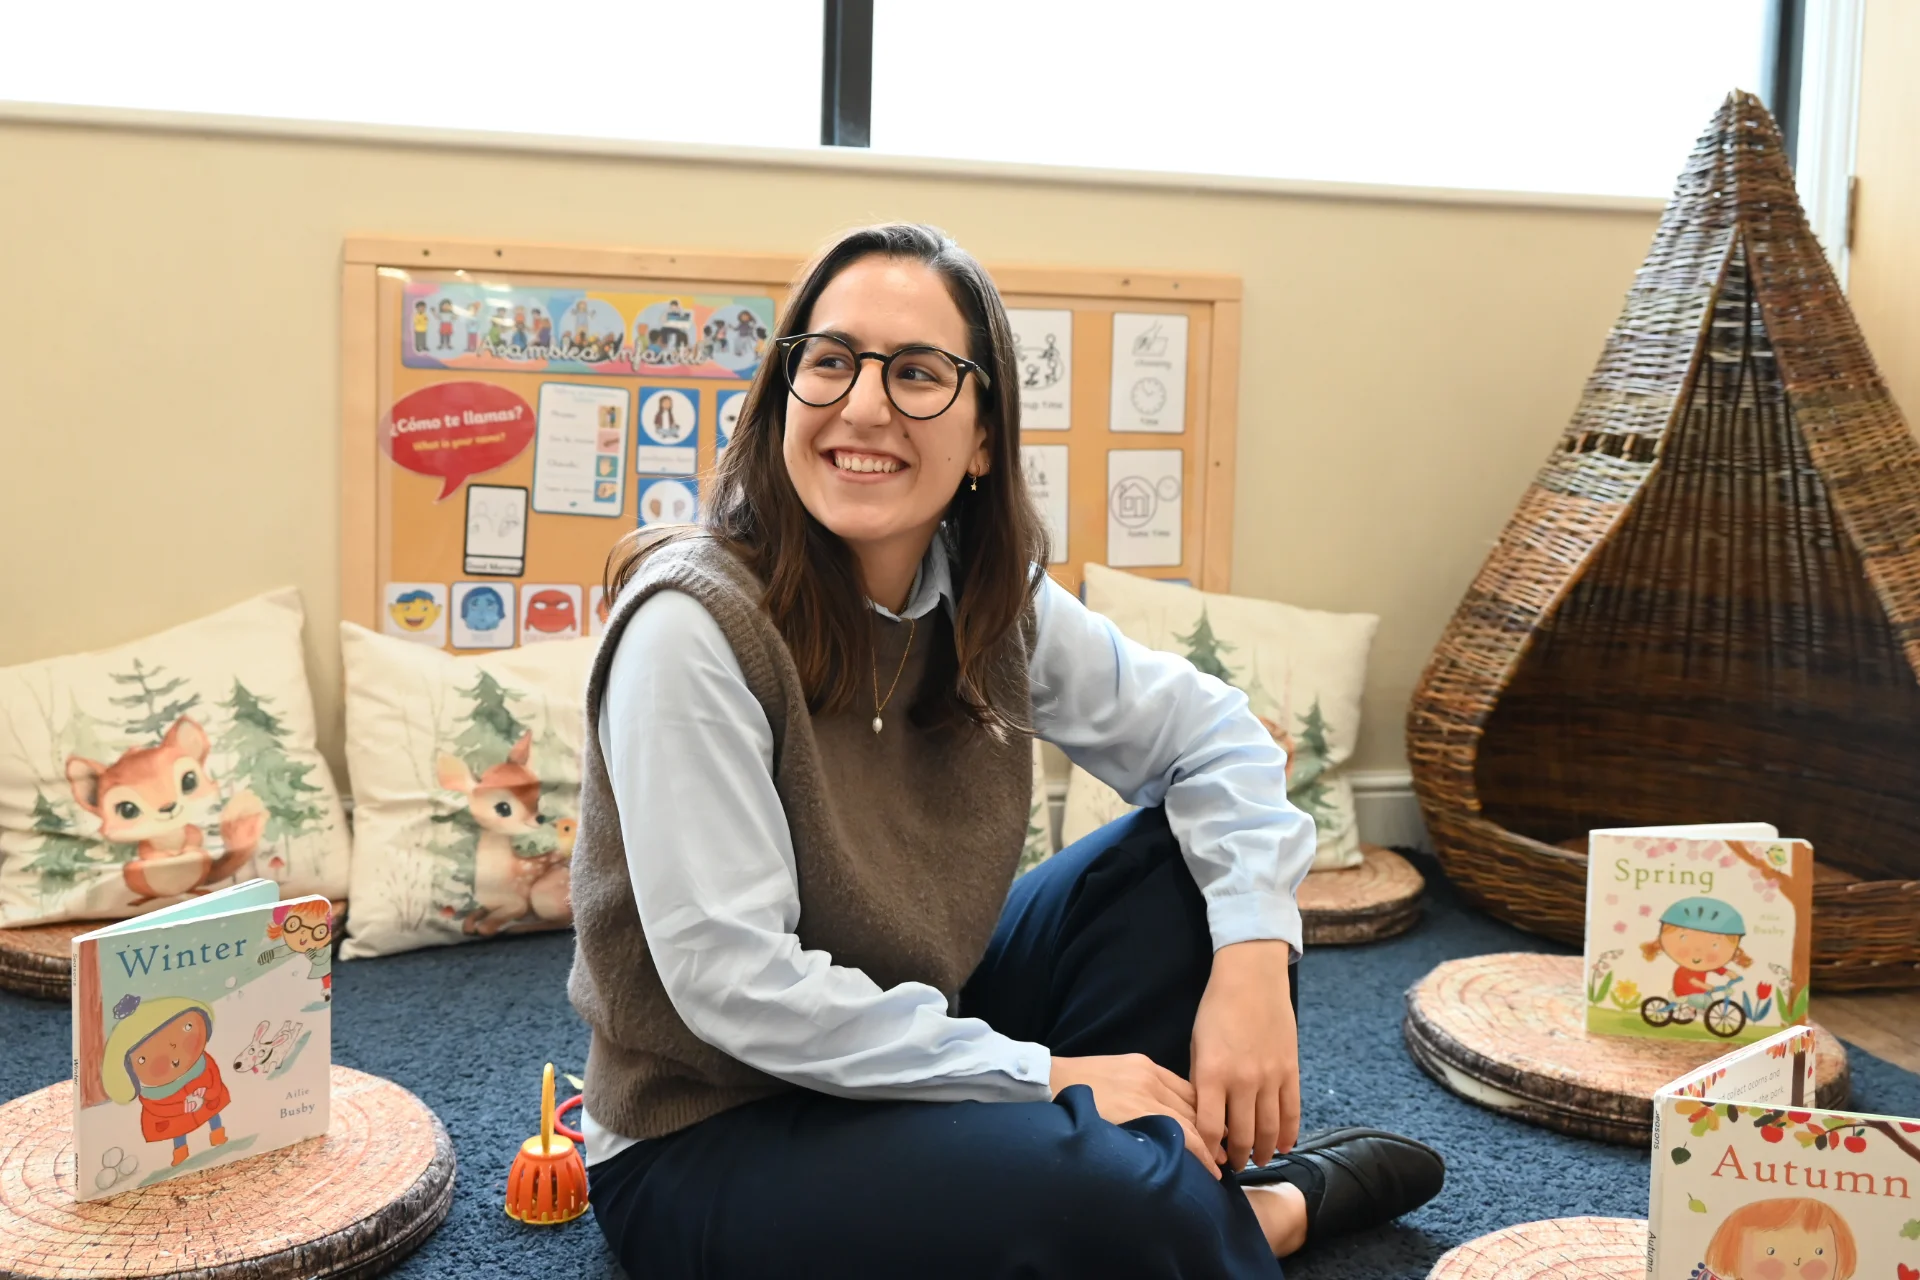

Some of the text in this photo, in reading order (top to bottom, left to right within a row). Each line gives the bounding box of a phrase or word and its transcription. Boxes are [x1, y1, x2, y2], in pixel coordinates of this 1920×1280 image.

[390, 405, 523, 437] ¿Cómo te llamas?
[1614, 858, 1715, 894] Spring
[116, 938, 247, 979] Winter
[280, 1102, 315, 1119] Busby
[285, 1088, 310, 1100] Ailie
[1711, 1144, 1911, 1199] Autumn
[1646, 1230, 1657, 1273] Autumn
